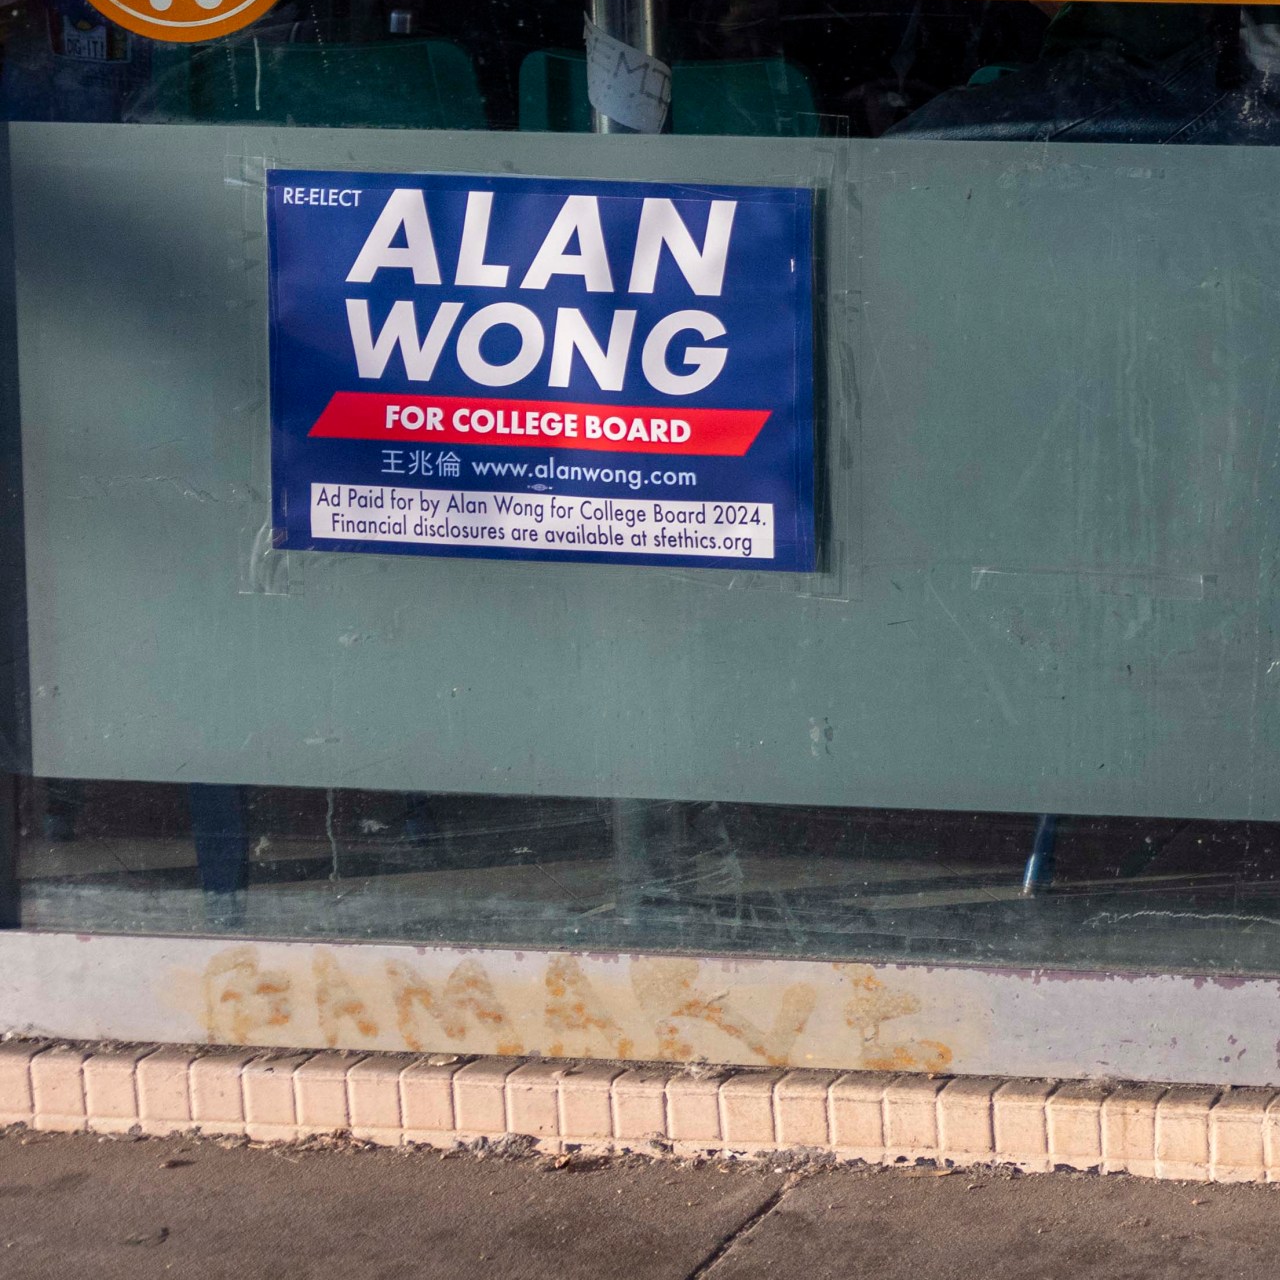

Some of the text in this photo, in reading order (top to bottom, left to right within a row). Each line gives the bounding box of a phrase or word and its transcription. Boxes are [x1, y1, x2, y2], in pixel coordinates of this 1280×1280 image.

[282, 185, 363, 209] RE-ELECT
[345, 187, 738, 297] ALAN
[345, 298, 729, 396] WONG
[385, 404, 692, 444] FOR COLLEGE BOARD
[380, 449, 462, 479] 王兆倫
[471, 455, 697, 489] www.alanwong.com
[317, 486, 766, 527] Ad Paid for by Alan Wong for College Board 2024.
[332, 513, 752, 556] Financial disclosures are available at sfethics.org
